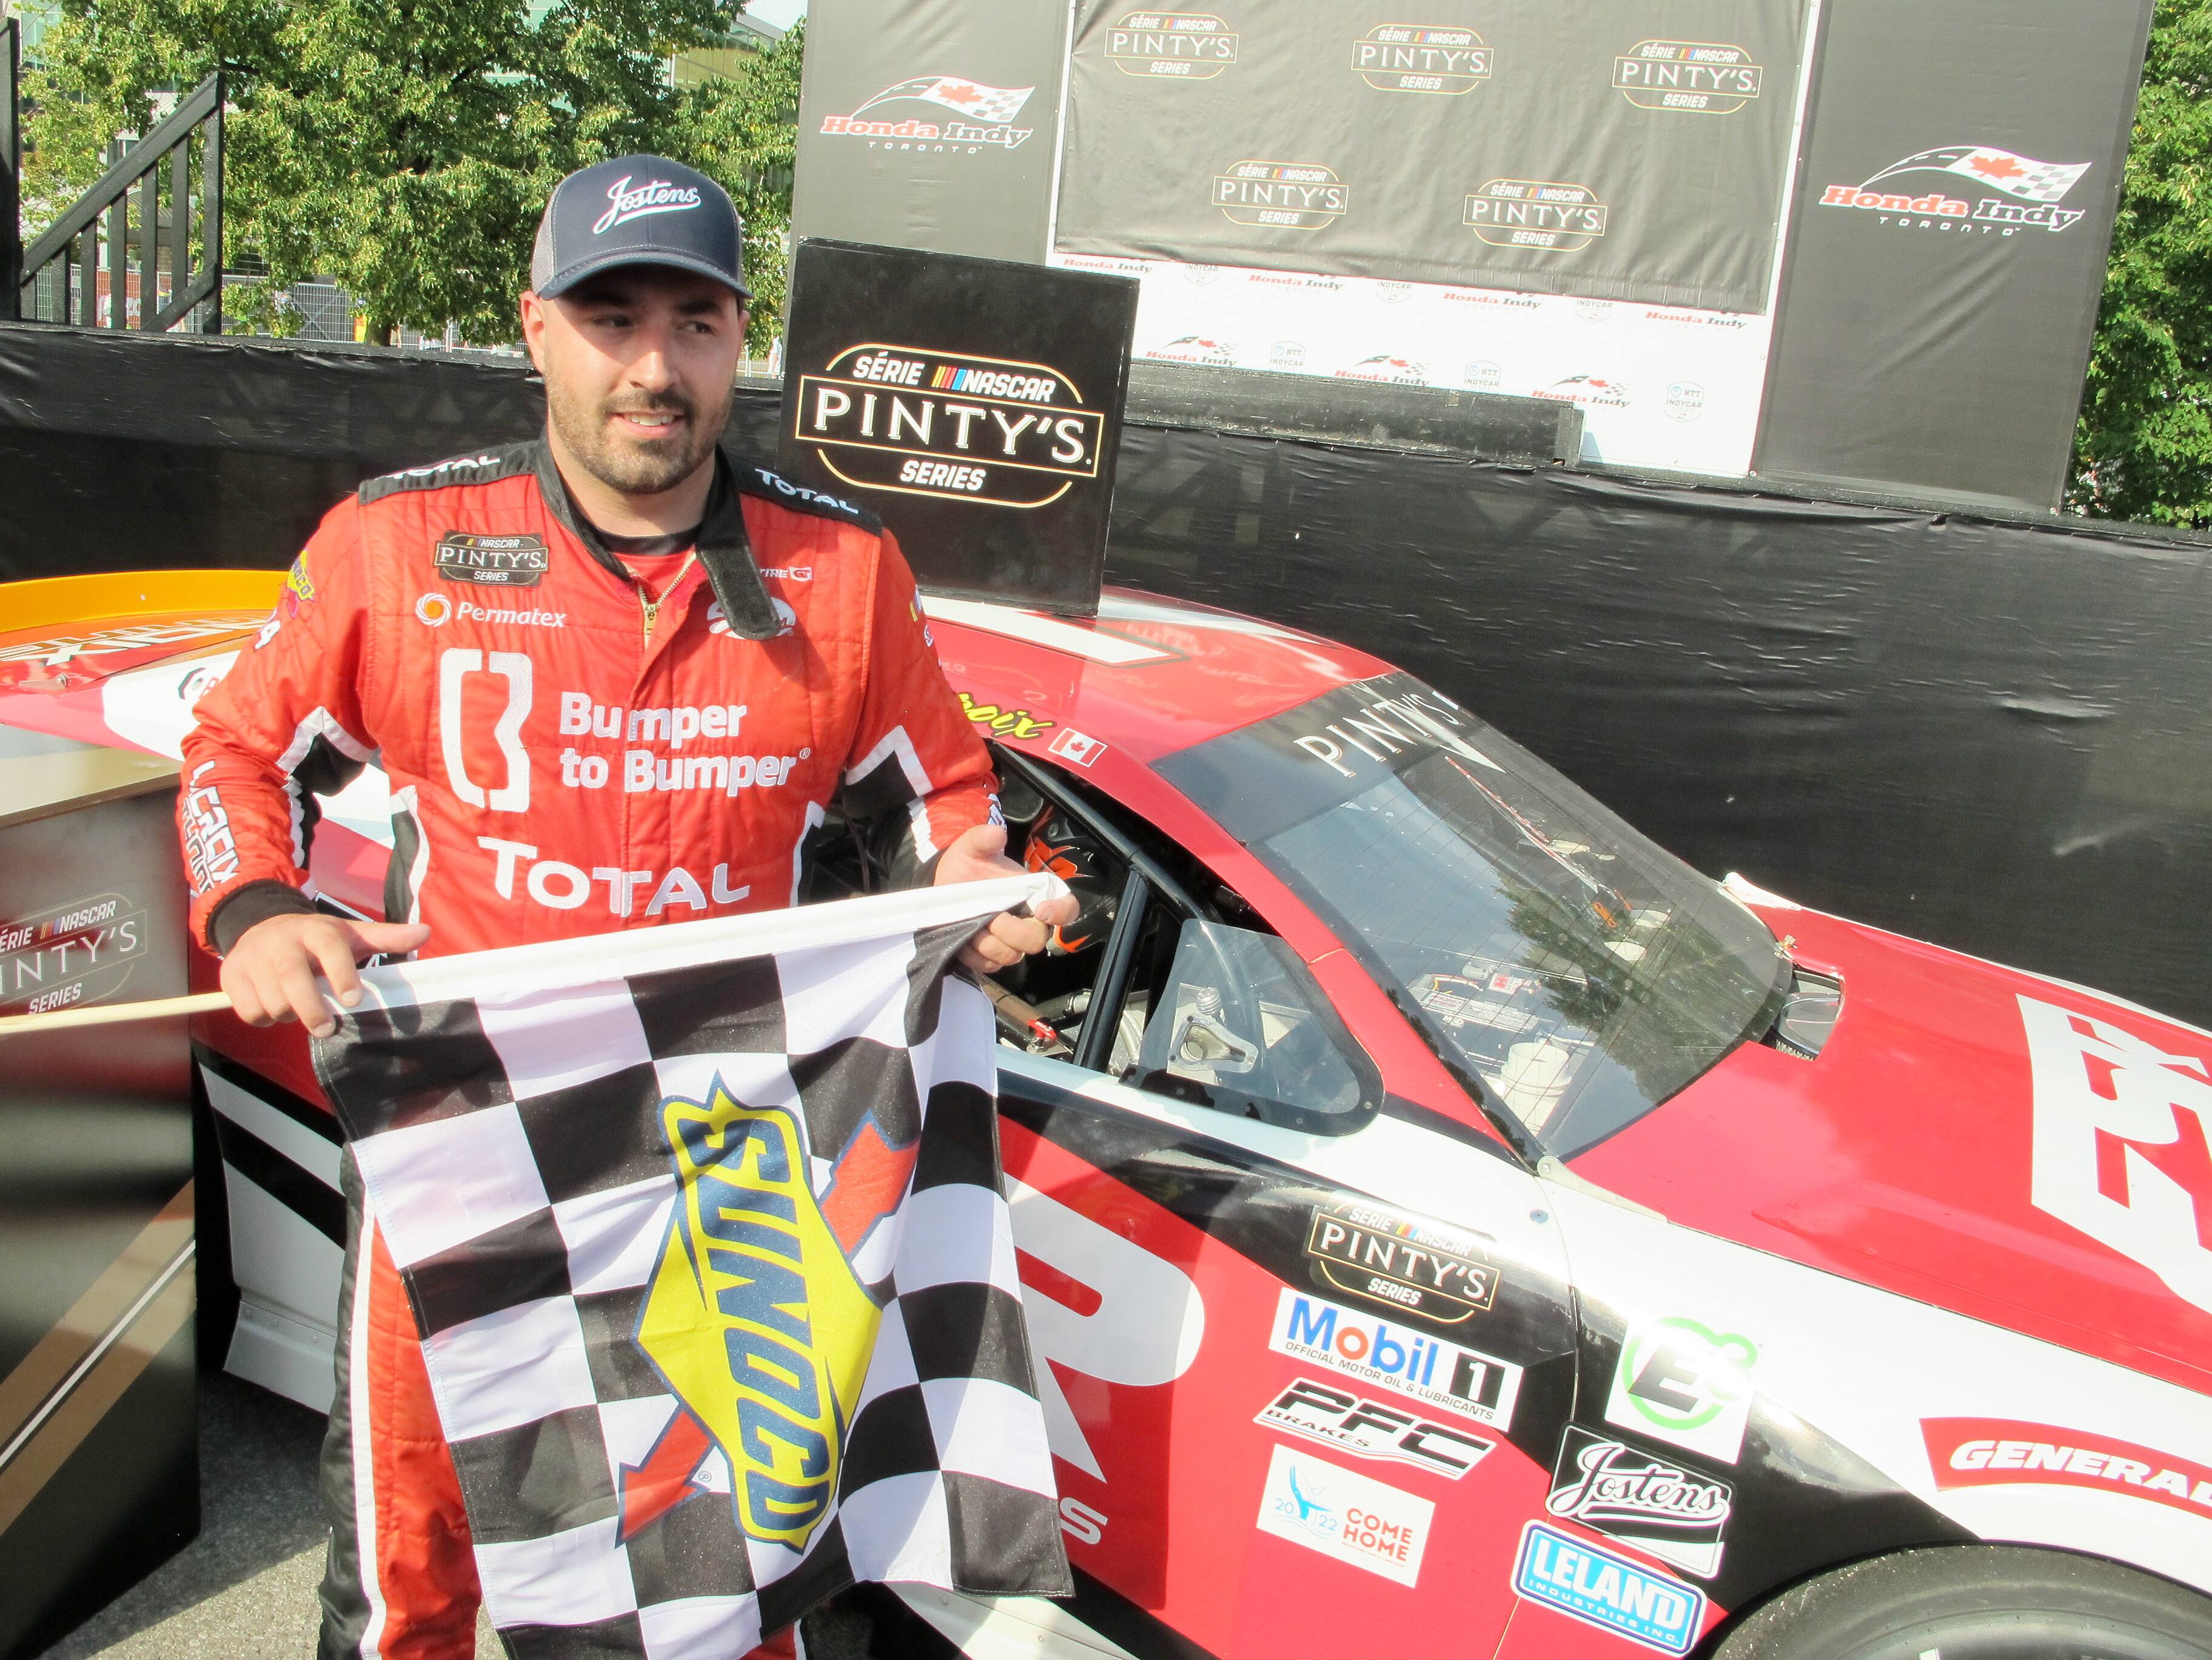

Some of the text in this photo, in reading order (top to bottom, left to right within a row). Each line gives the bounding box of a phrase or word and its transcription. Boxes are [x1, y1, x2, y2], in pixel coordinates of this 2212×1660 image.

[1129, 16, 1217, 32] SÉRIE NASCAR
[1378, 27, 1470, 45] SÉRIE NASCAR
[1150, 61, 1191, 75] SERIES
[1640, 44, 1740, 64] SÉRIE NASCAR
[1399, 75, 1443, 90] SERIES
[1662, 95, 1708, 109] SERIES
[820, 115, 1033, 149] Honda Indy
[868, 141, 977, 155] TORONTO
[1237, 164, 1326, 182] SÉRIE NASCAR
[592, 175, 701, 235] Jostens
[1490, 183, 1584, 203] SÉRIE NASCAR
[1258, 211, 1300, 225] SERIES
[1818, 185, 2085, 232] Honda Indy
[1511, 232, 1555, 246] SERIES
[1879, 217, 2013, 237] TORONTO
[1062, 259, 1153, 273] Honda Indy
[1249, 275, 1301, 285] Honda
[1306, 280, 1342, 291] Indy
[1443, 292, 1498, 304] Honda
[1502, 298, 1541, 309] Indy
[1576, 300, 1612, 308] INDYCAR
[1646, 312, 1702, 323] Honda
[1706, 318, 1746, 329] Indy
[1145, 351, 1236, 367] Honda Indy
[853, 351, 1056, 403] SÉRIE NASCAR
[1335, 371, 1430, 386] Honda Indy
[1532, 391, 1586, 402] Honda
[1590, 397, 1630, 408] Indy
[1666, 399, 1702, 408] INDYCAR
[900, 460, 987, 491] SERIES
[754, 468, 859, 514] TOTAL
[480, 539, 520, 549] NASCAR
[474, 571, 509, 582] SERIES
[457, 602, 567, 628] Permatex
[560, 691, 746, 748] Bumper
[561, 747, 609, 787] to
[478, 836, 750, 918] TOTAL
[0, 900, 116, 953] ÉRIE NASCAR
[0, 921, 137, 995] INTY'S
[29, 982, 82, 1015] SERIES
[1413, 1228, 1472, 1257] NASCAR
[1367, 1277, 1422, 1306] SERIES
[677, 1117, 833, 1531] SUNOCO
[1287, 1297, 1439, 1386] Mobil
[1285, 1341, 1494, 1420] OFFICIAL MOTOR OIL & LUBRICANTS
[1266, 1410, 1370, 1447] BRAKES
[1275, 1380, 1491, 1469] PFC
[1545, 1442, 1729, 1525] Jostens
[1274, 1497, 1338, 1531] 20 22
[1347, 1508, 1413, 1544] COME
[1343, 1524, 1409, 1561] HOME
[1533, 1537, 1687, 1631] LELAND
[1529, 1579, 1680, 1644] INDUSTRIES INC.
